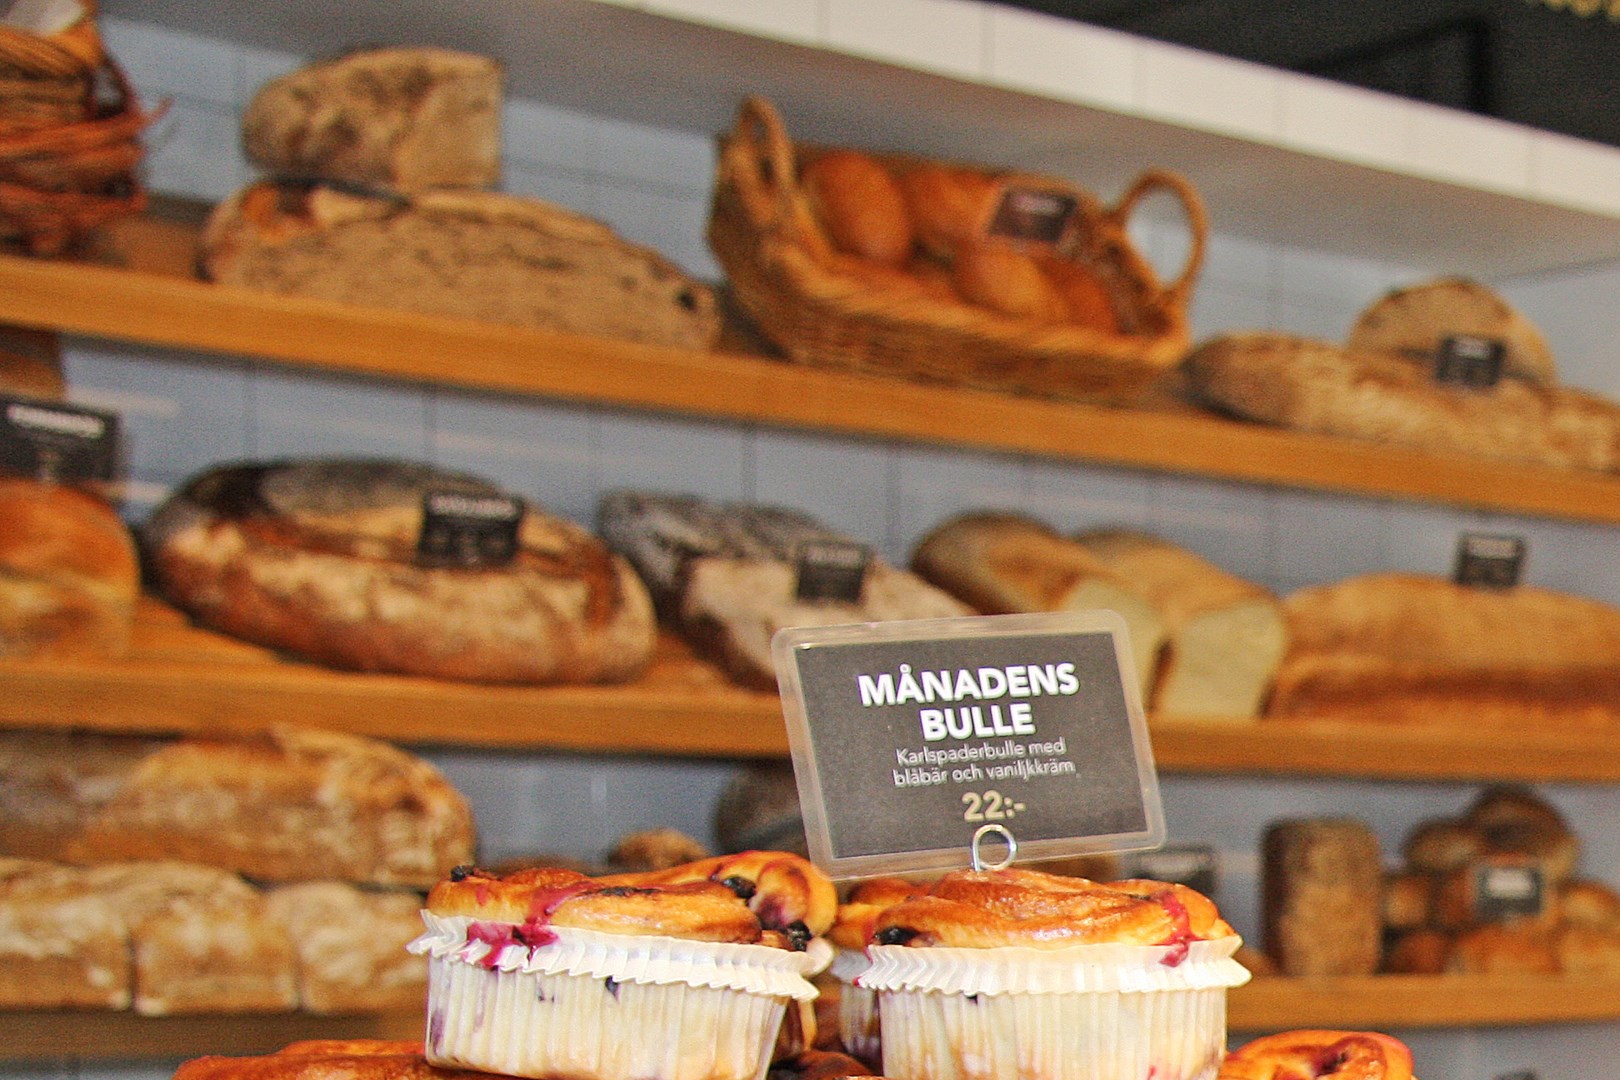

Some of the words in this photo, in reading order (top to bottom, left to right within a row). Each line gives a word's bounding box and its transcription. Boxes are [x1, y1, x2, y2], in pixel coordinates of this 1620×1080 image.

[858, 663, 1080, 706] MÅNADENS
[920, 703, 1036, 741] BULLE
[896, 739, 1026, 767] Karlspaderbulle
[1029, 736, 1067, 756] med
[893, 767, 948, 788] blåbär
[952, 763, 983, 783] och
[961, 789, 1027, 823] 22:-
